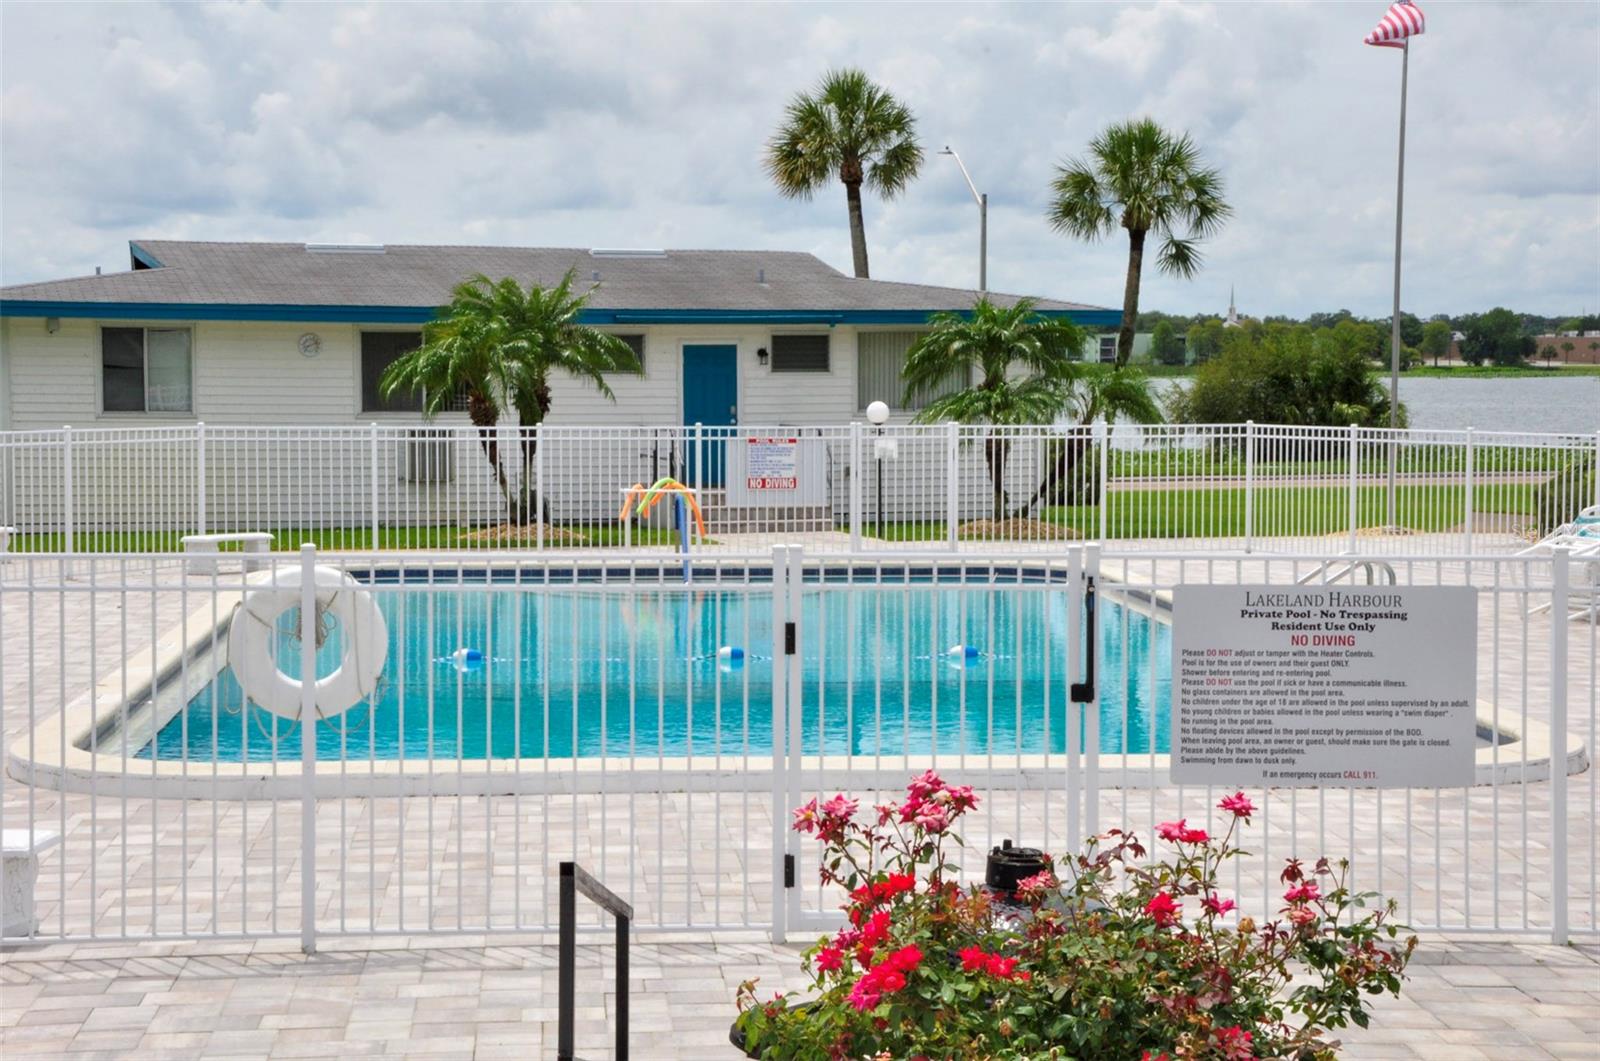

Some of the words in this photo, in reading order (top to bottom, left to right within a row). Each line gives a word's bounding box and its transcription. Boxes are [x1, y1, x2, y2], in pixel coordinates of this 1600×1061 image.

[750, 478, 762, 489] NO
[765, 478, 794, 489] DIVING
[1240, 609, 1283, 618] Private
[1286, 610, 1311, 618] Pool
[1320, 610, 1336, 618] No
[1338, 610, 1408, 620] Trespassing
[1272, 622, 1322, 631] Resident
[1324, 622, 1346, 631] Use
[1348, 622, 1376, 633] Only
[1291, 635, 1308, 646] NO
[1313, 635, 1355, 646] DIVING
[1192, 727, 1217, 735] floating
[1202, 738, 1226, 746] leaving
[1226, 747, 1234, 755] by
[1181, 756, 1216, 764] Swimming
